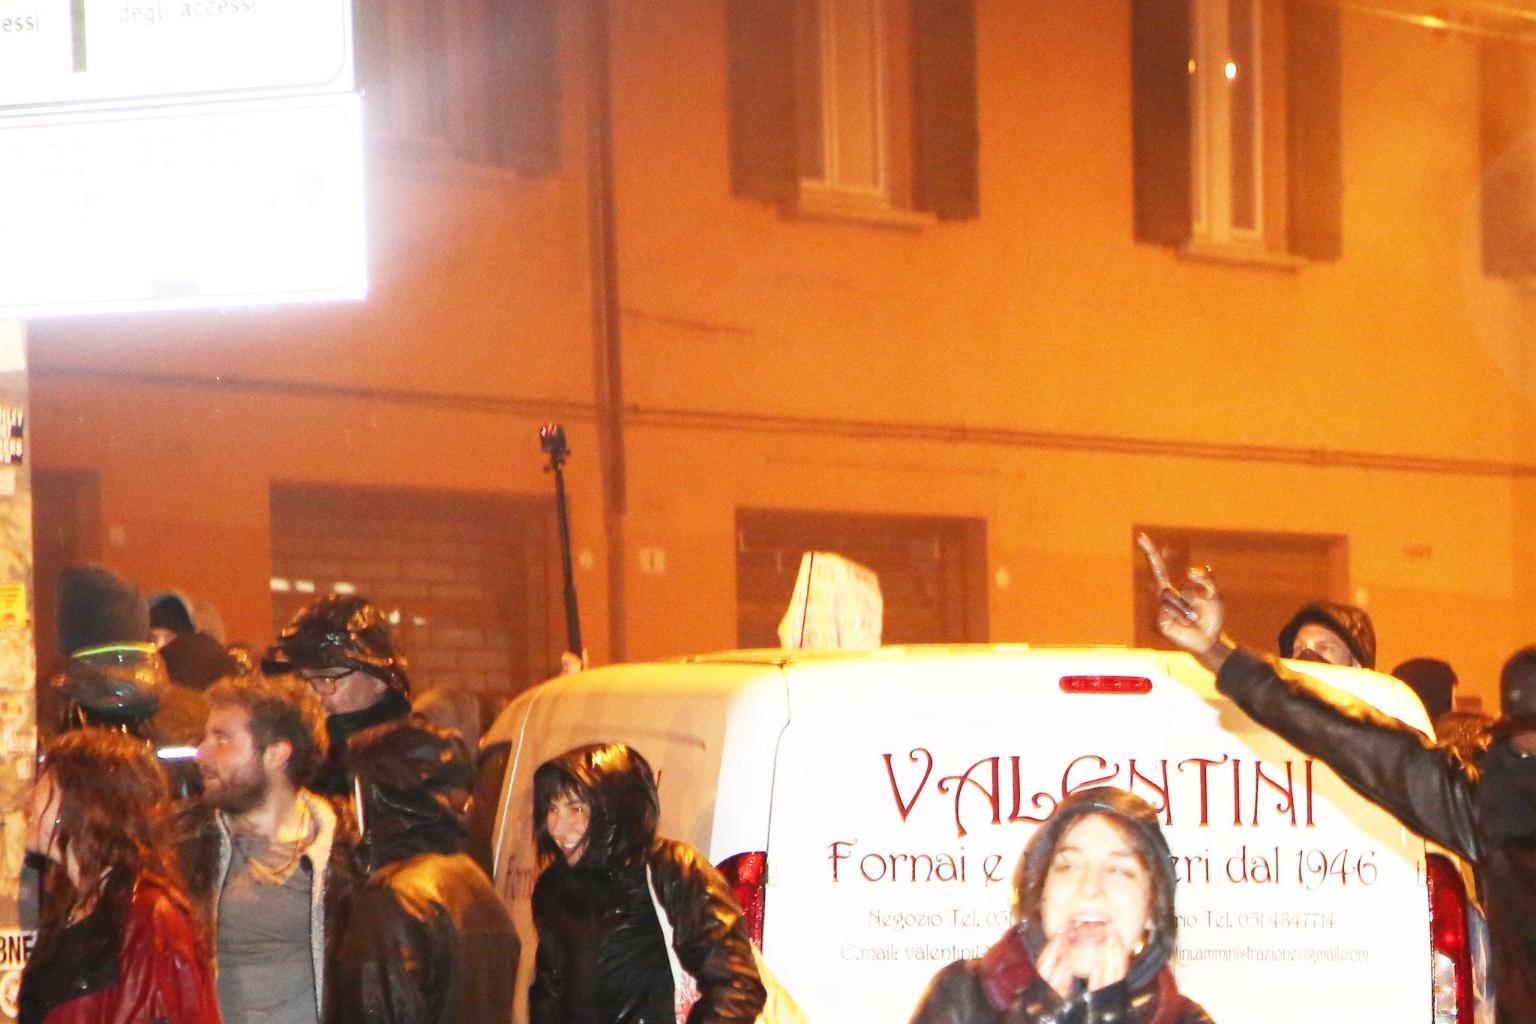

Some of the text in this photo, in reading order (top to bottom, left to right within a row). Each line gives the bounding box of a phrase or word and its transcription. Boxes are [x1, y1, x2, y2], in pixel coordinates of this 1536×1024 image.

[882, 747, 1315, 838] VALENTINI
[827, 839, 966, 882] Fornai
[983, 854, 1006, 886] e
[1226, 845, 1280, 884] dal
[1296, 848, 1378, 891] 1946
[868, 908, 943, 931] Negozio
[951, 907, 981, 928] Tel.
[1206, 909, 1233, 929] Tel.
[1238, 910, 1265, 929] 051
